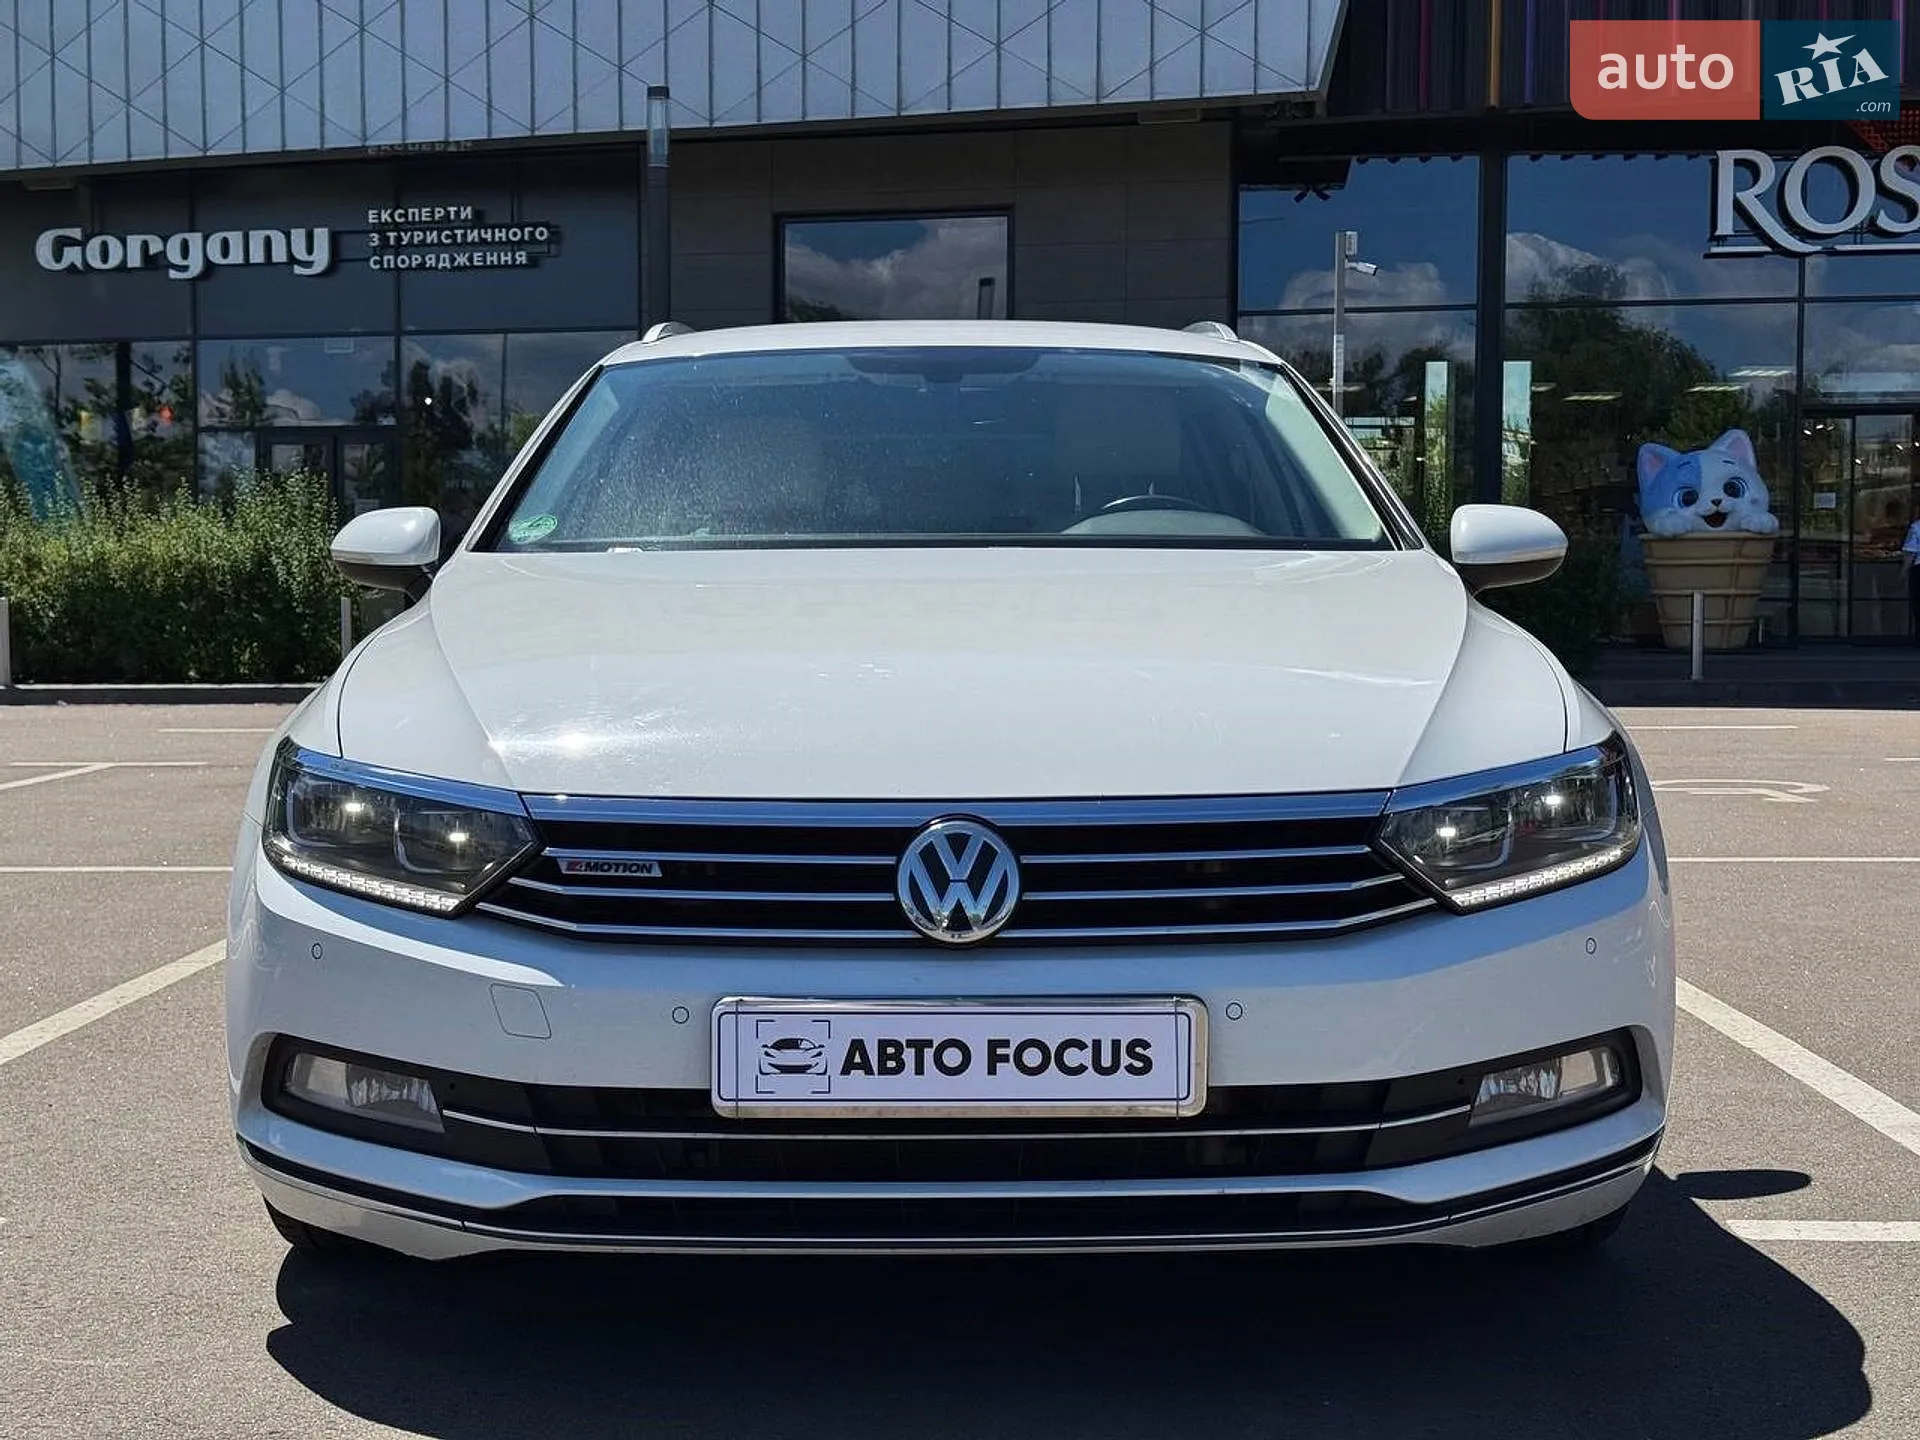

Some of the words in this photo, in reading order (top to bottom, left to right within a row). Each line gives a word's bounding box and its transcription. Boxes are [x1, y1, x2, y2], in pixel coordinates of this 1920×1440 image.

[368, 206, 473, 224] ЕКСПЕРТИ
[386, 227, 549, 246] ТУРИСТИЧНОГО
[35, 227, 329, 279] Gorgany
[369, 251, 528, 270] СПОРЯДЖЕННЯ
[986, 1038, 1154, 1077] FOCUS
